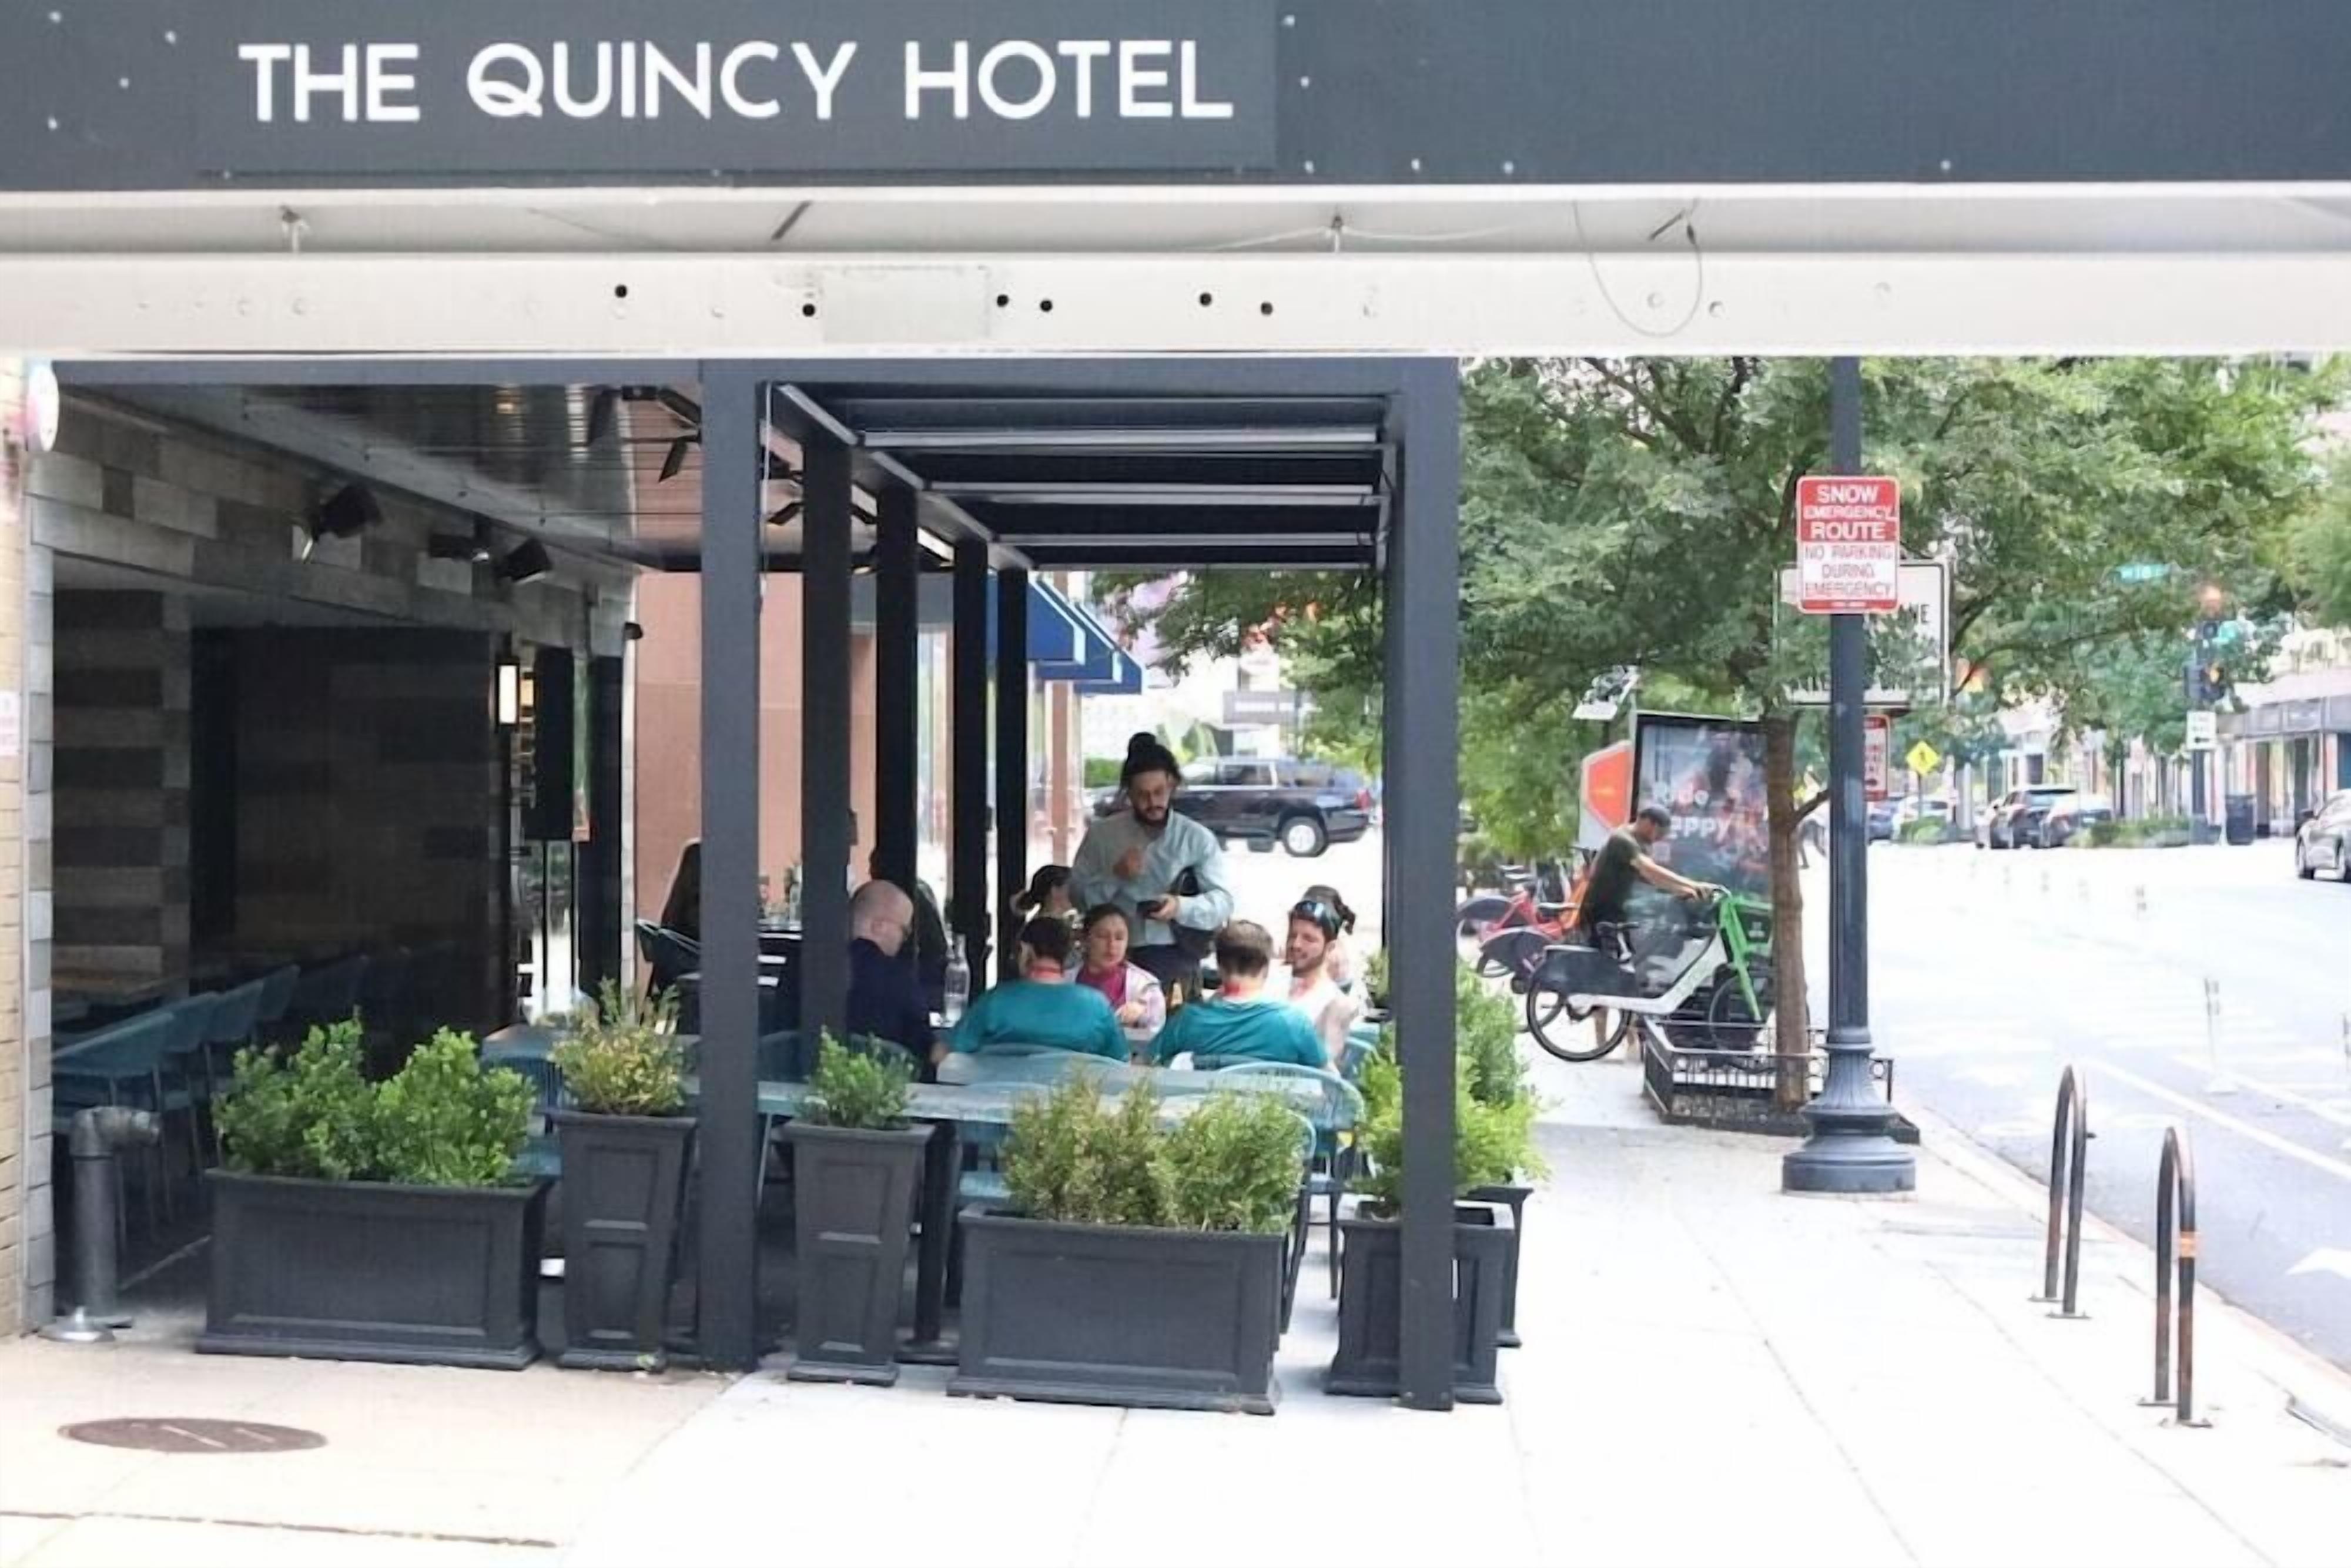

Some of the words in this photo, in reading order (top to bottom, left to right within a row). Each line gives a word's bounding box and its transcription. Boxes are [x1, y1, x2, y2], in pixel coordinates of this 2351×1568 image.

[237, 43, 420, 122] THE
[466, 41, 857, 120] QUINCY
[905, 39, 1234, 119] HOTEL
[1816, 484, 1879, 503] SNOW
[1803, 506, 1894, 520] EMERGENCY
[1810, 521, 1886, 539] ROUTE
[1805, 545, 1824, 559] NO
[1831, 545, 1893, 559] PARKING
[1822, 563, 1875, 578] DURING
[1805, 582, 1891, 598] EMERGENCY
